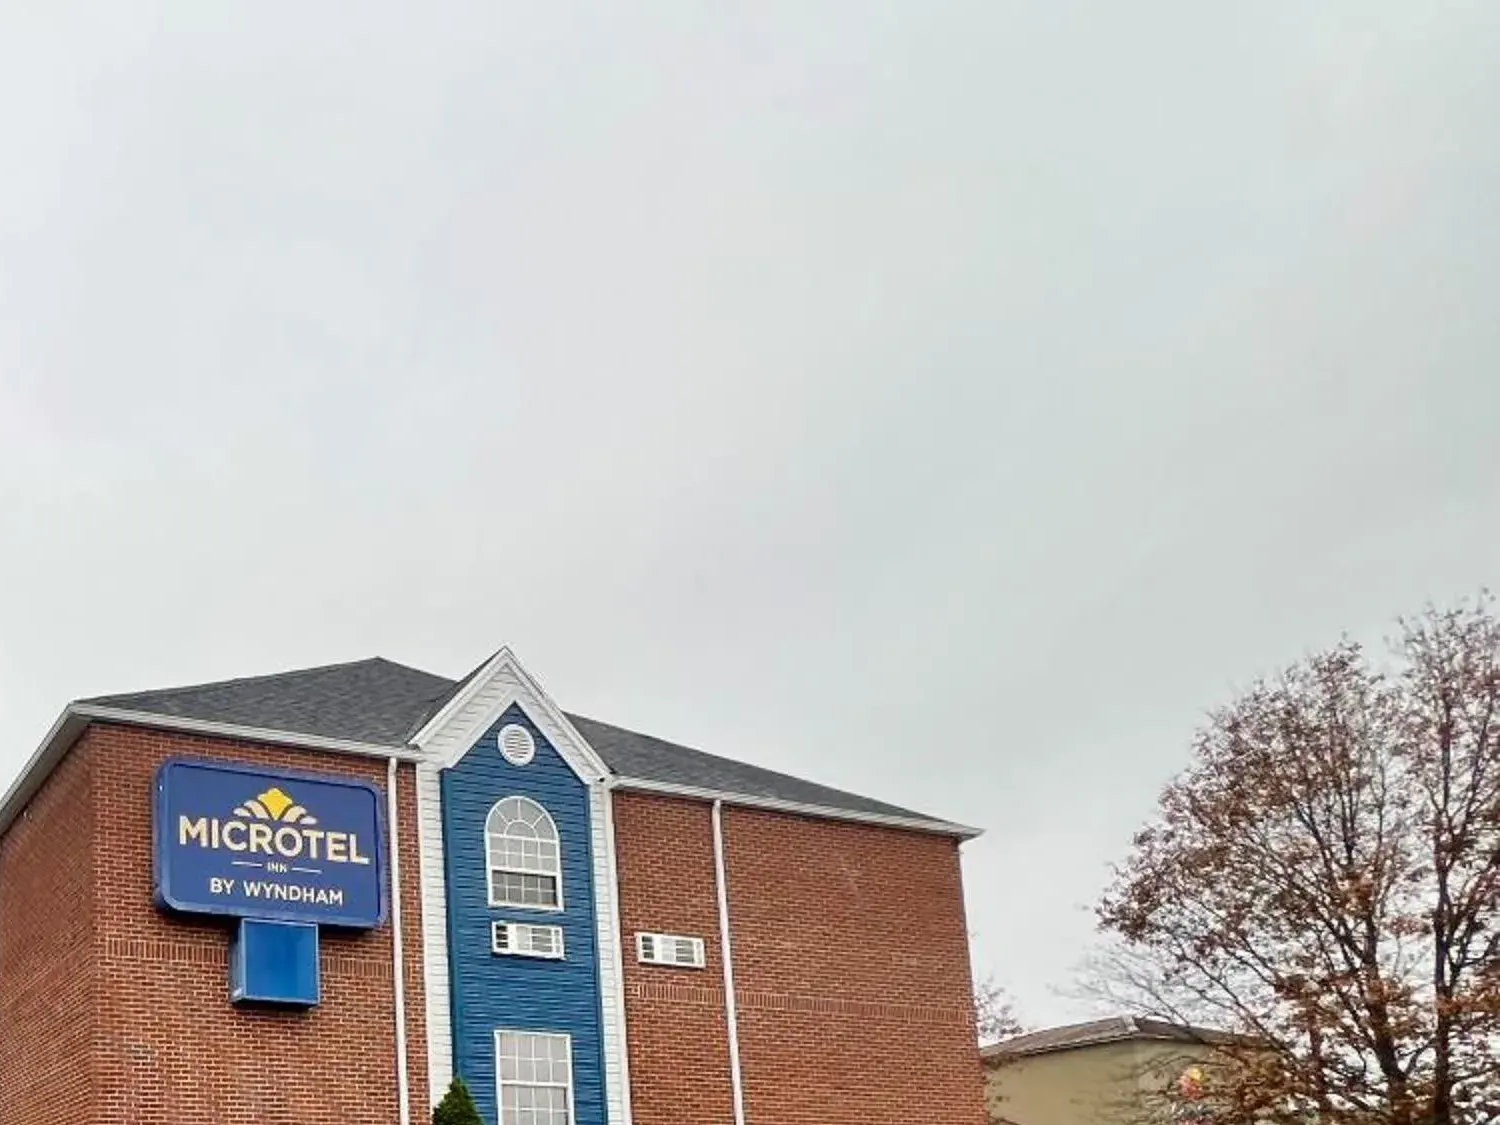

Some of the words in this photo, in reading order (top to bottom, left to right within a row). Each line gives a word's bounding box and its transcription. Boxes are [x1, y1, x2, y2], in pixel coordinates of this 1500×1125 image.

[179, 815, 370, 865] MICROTEL
[267, 861, 288, 873] INN
[210, 877, 235, 895] BY
[243, 880, 343, 906] WYNDHAM
